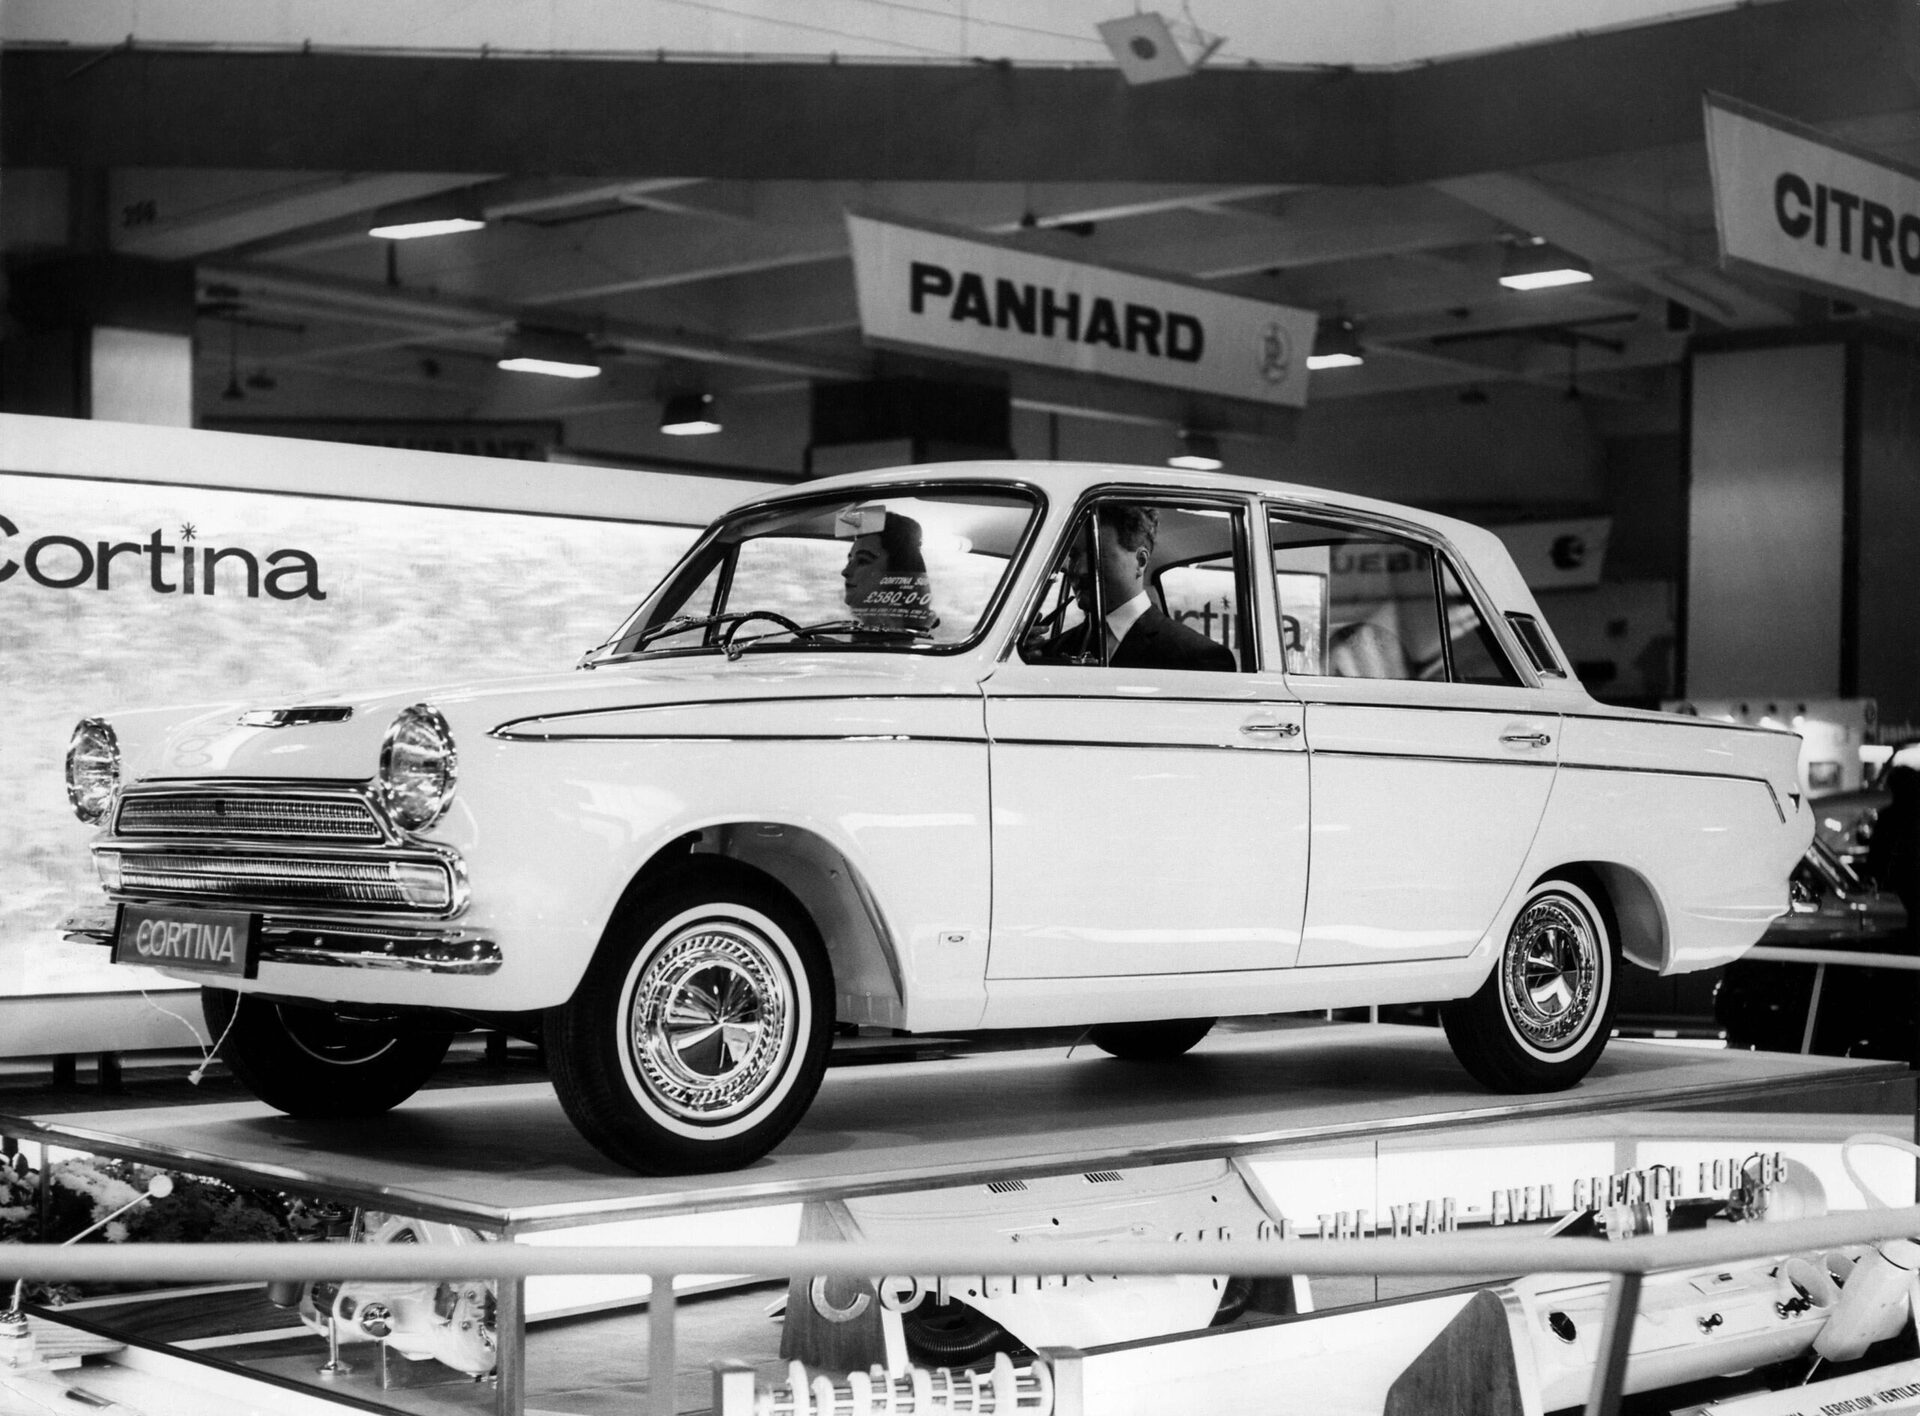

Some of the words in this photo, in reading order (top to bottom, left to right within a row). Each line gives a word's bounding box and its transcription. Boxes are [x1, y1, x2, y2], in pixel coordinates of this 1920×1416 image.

[910, 261, 1205, 363] PANHARD
[136, 919, 236, 963] CORTINA
[1317, 1209, 1368, 1241] THE
[1390, 1197, 1457, 1237] YEAR
[1490, 1183, 1553, 1226] EVEN
[1573, 1166, 1684, 1211] GREATER
[1700, 1158, 1743, 1193] FOR
